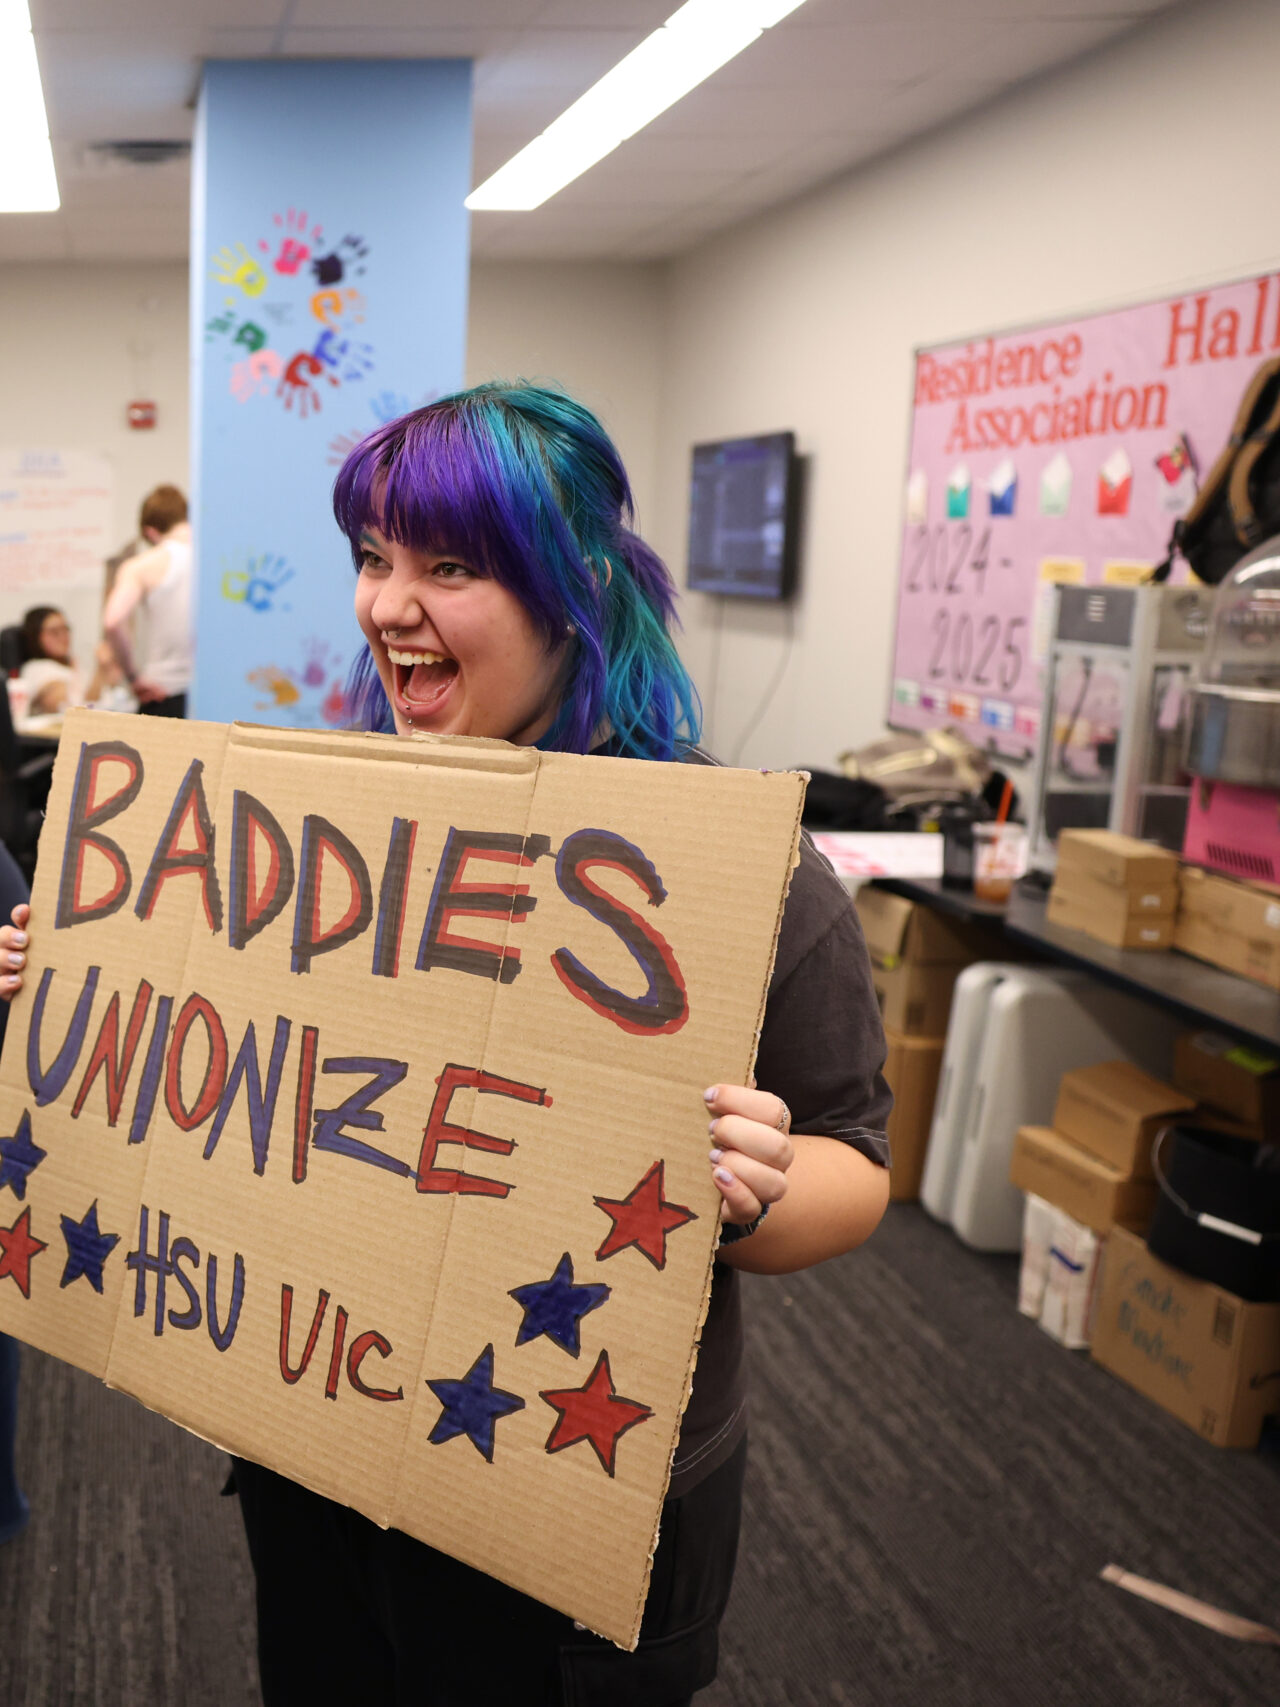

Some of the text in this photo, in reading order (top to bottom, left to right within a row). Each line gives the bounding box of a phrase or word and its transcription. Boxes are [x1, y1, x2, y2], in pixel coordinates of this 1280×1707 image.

[915, 333, 1083, 405] Residence
[946, 374, 1168, 453] Association
[927, 606, 1027, 693] 2025
[55, 740, 690, 1036] BADDIES
[26, 965, 554, 1200] UNIONIZE
[126, 1204, 405, 1402] HSU UIC
